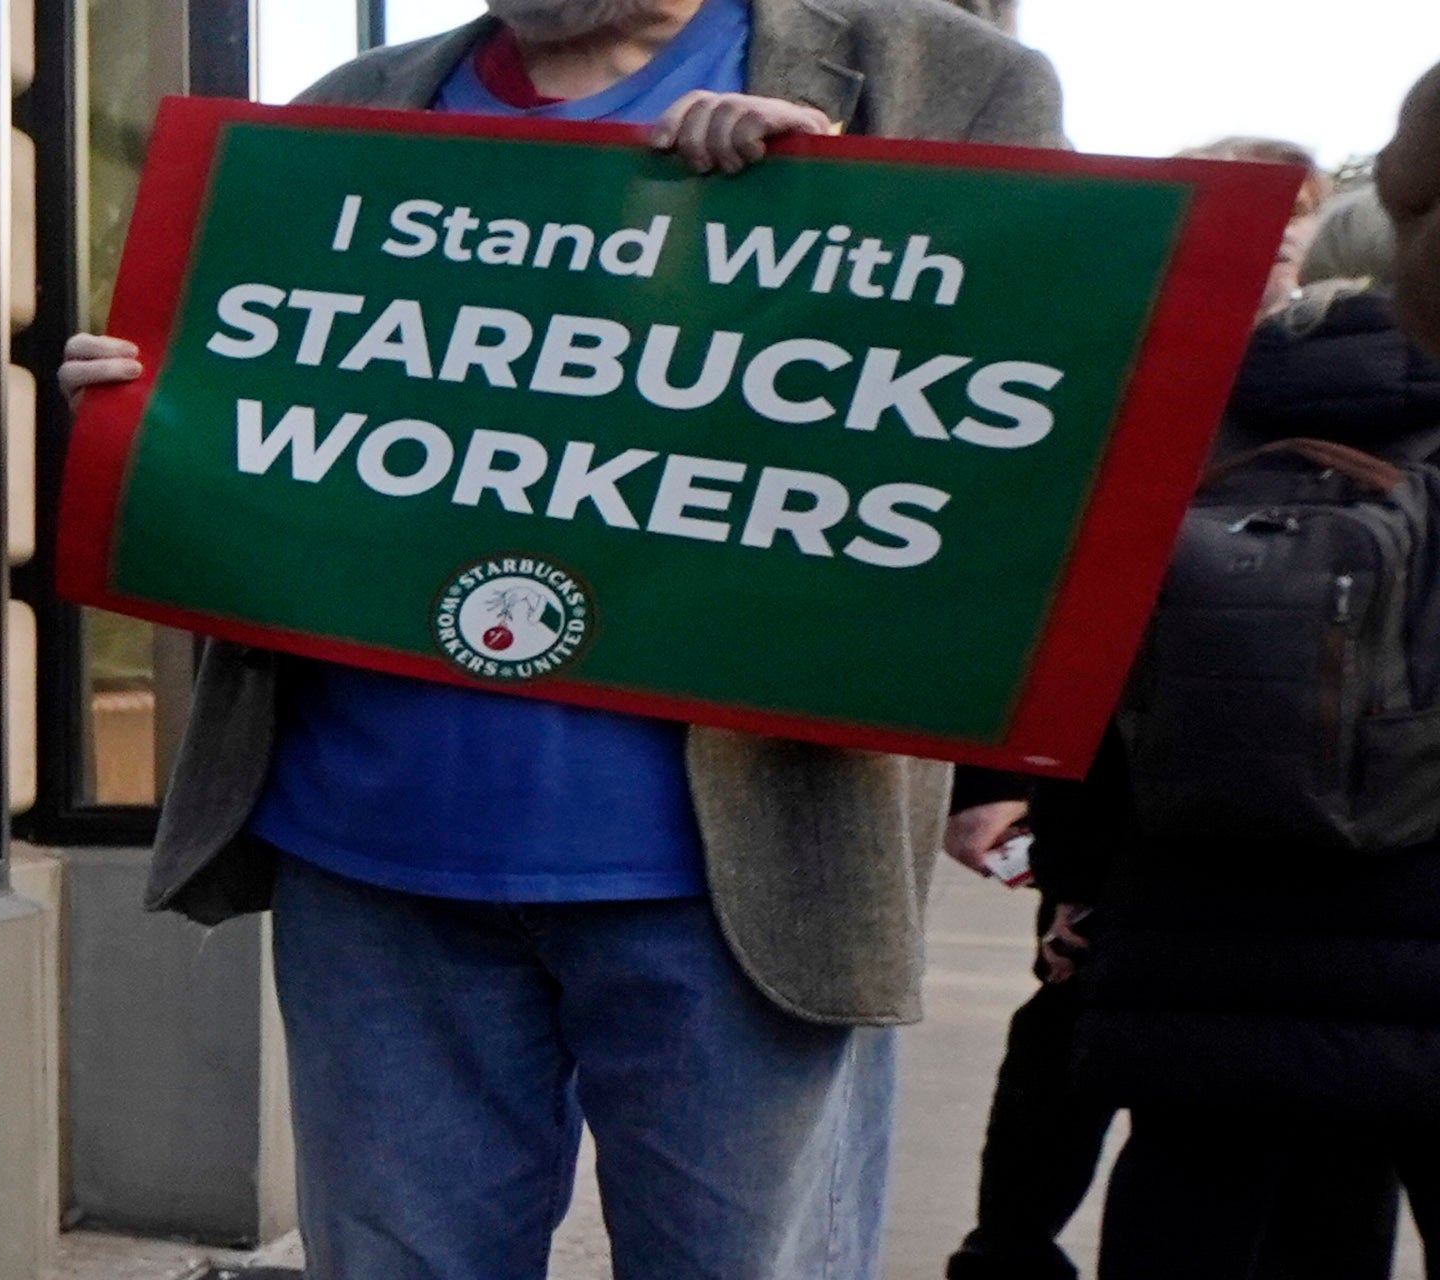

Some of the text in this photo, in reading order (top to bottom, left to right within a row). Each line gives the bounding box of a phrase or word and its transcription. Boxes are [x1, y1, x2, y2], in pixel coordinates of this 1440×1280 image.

[330, 194, 965, 306] I Stand With
[205, 282, 1066, 449] STARBUCKS
[236, 397, 953, 569] WORKERS
[458, 558, 585, 607] STARBUCKS
[437, 596, 499, 676] WORKERS
[515, 618, 586, 678] UNITED
